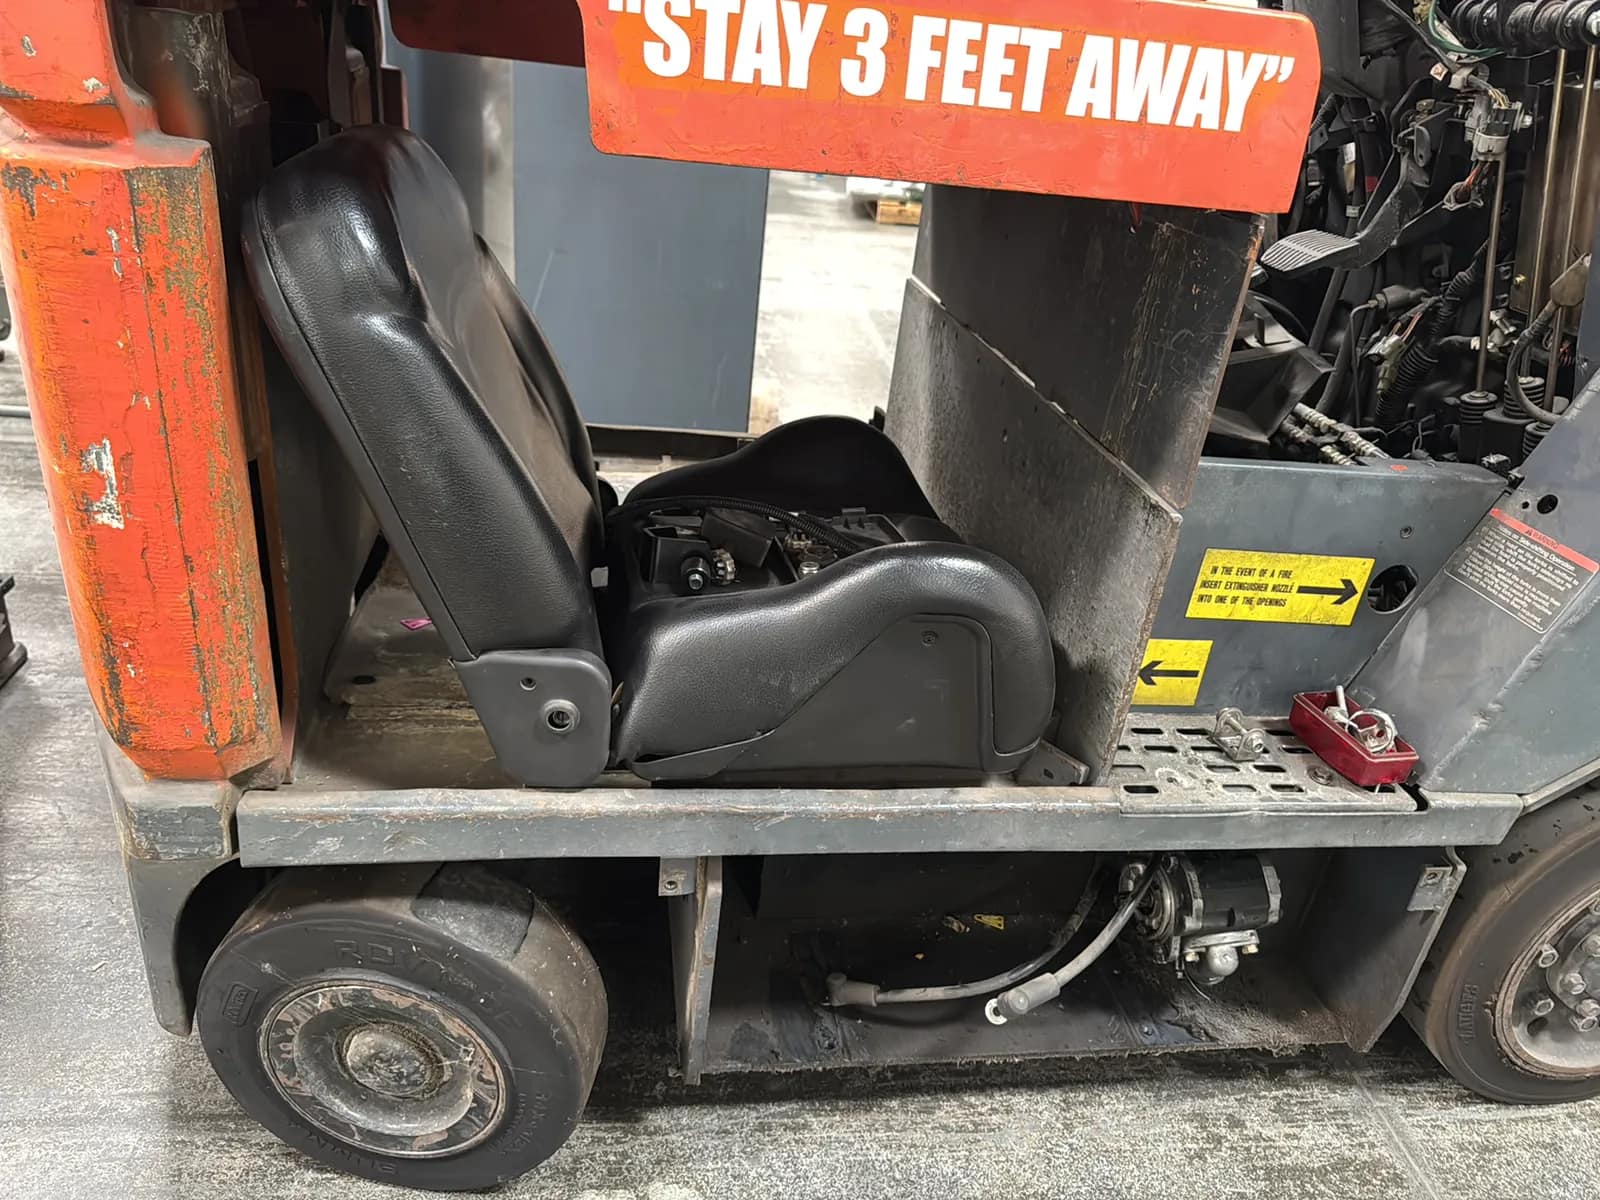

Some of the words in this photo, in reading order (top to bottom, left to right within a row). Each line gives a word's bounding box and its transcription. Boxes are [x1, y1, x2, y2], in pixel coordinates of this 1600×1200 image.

[840, 8, 890, 97] 3
[905, 15, 1063, 114] FEET
[1210, 566, 1219, 575] IN
[1221, 566, 1234, 575] THE
[1235, 567, 1256, 577] EVENT
[1259, 568, 1268, 577] OF
[1278, 569, 1293, 579] FIRE
[1199, 580, 1222, 589] INSERT
[1224, 581, 1269, 592] EXTINGUISHER
[1271, 583, 1294, 593] NOZZLE
[1197, 594, 1213, 603] INTO
[1214, 595, 1228, 604] ONE
[1230, 595, 1240, 604] OF
[1242, 596, 1255, 605] THE
[1256, 597, 1287, 607] OPENINGS
